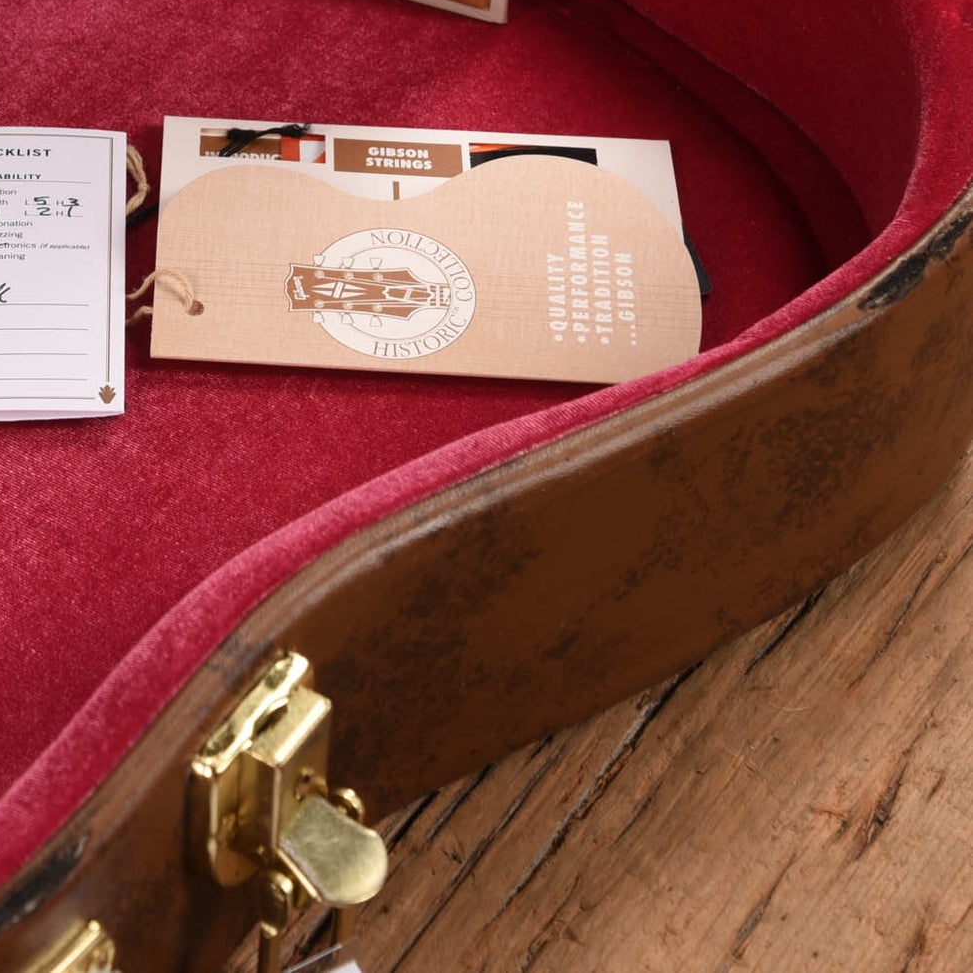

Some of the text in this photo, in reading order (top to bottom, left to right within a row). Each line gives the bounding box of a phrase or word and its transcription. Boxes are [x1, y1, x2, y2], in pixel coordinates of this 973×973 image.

[365, 157, 433, 170] STRINGS
[368, 146, 429, 158] GIBSON
[369, 230, 473, 358] HISTORIC COLLECTION
[546, 252, 568, 332] QUALITY
[566, 201, 590, 333] PERFORMANCE
[590, 234, 614, 334] TRADITION
